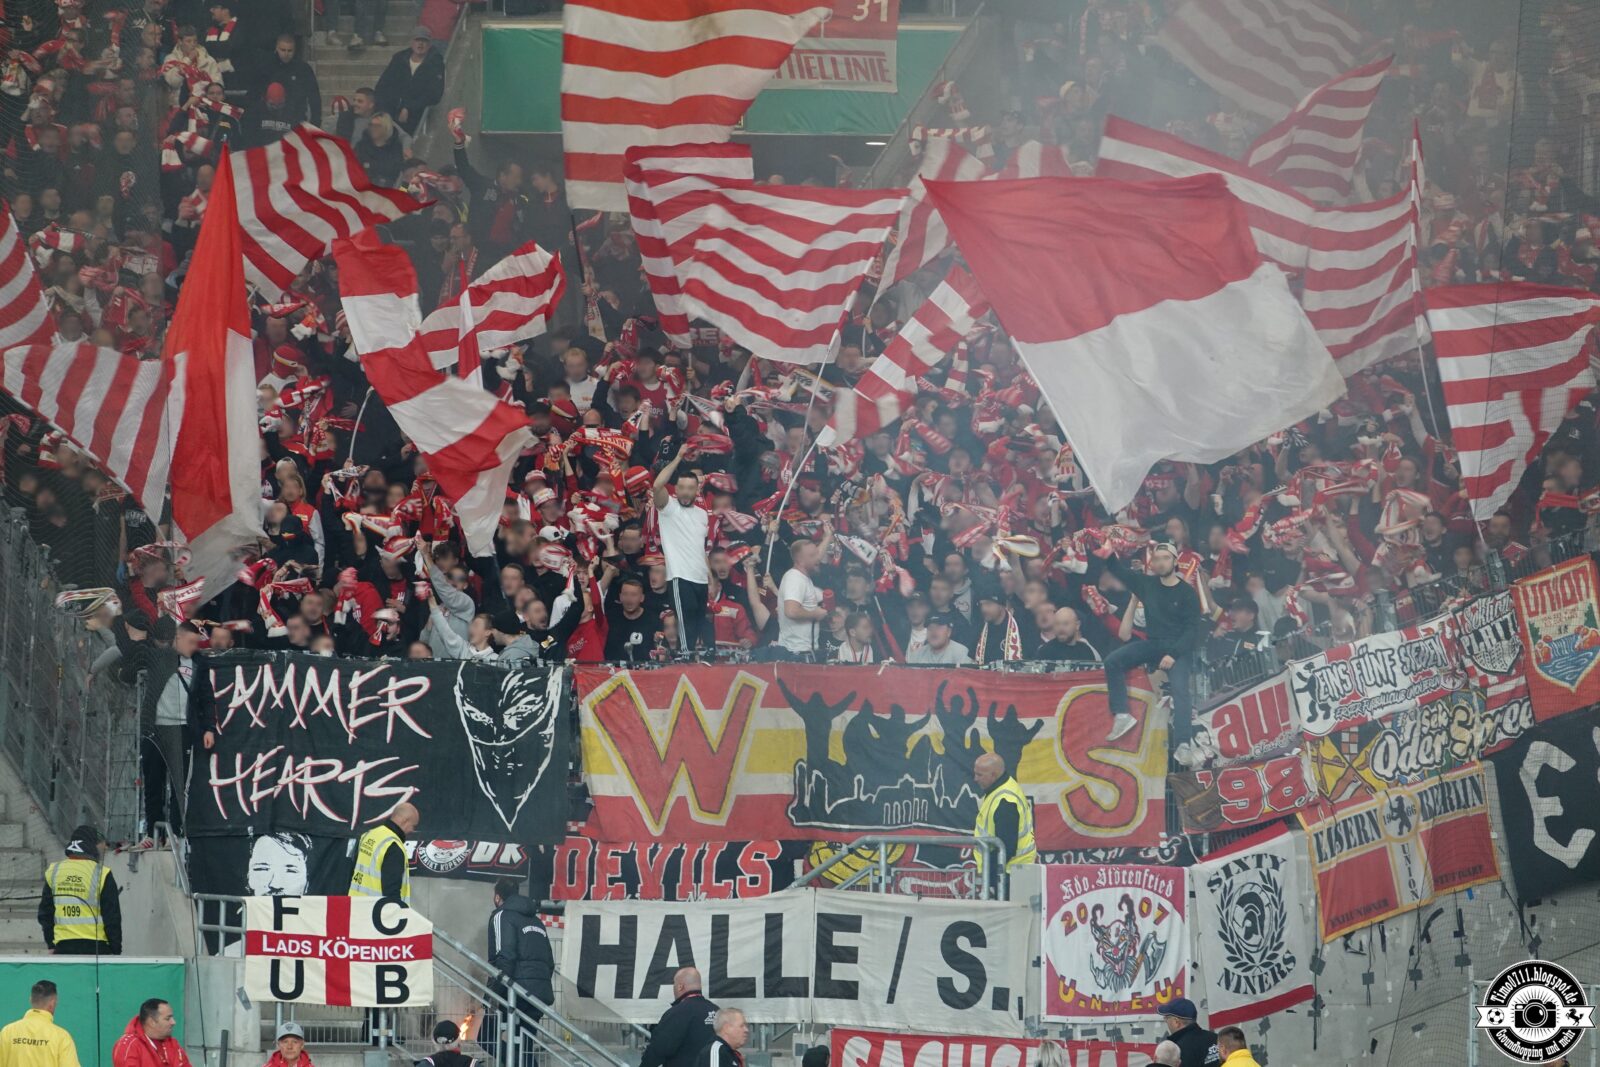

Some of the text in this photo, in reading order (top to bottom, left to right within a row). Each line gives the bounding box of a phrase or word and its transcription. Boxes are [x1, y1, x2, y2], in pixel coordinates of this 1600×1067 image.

[1314, 660, 1353, 703] EINS
[1350, 644, 1398, 697] FÜNF
[584, 669, 1159, 838] W S
[1372, 708, 1448, 781] Oder
[208, 745, 420, 830] HEARTS
[1417, 774, 1484, 822] BERLIN
[1313, 808, 1382, 864] EISERN
[550, 836, 783, 900] DEVILS
[1206, 853, 1288, 894] SIXTY
[1401, 842, 1420, 900] UNION
[62, 905, 81, 917] 1099
[272, 895, 410, 936] F C
[262, 934, 415, 961] LADS KÖPENICK
[270, 959, 410, 1005] U B
[1217, 950, 1298, 995] NINERS
[13, 1037, 49, 1047] SECURITY
